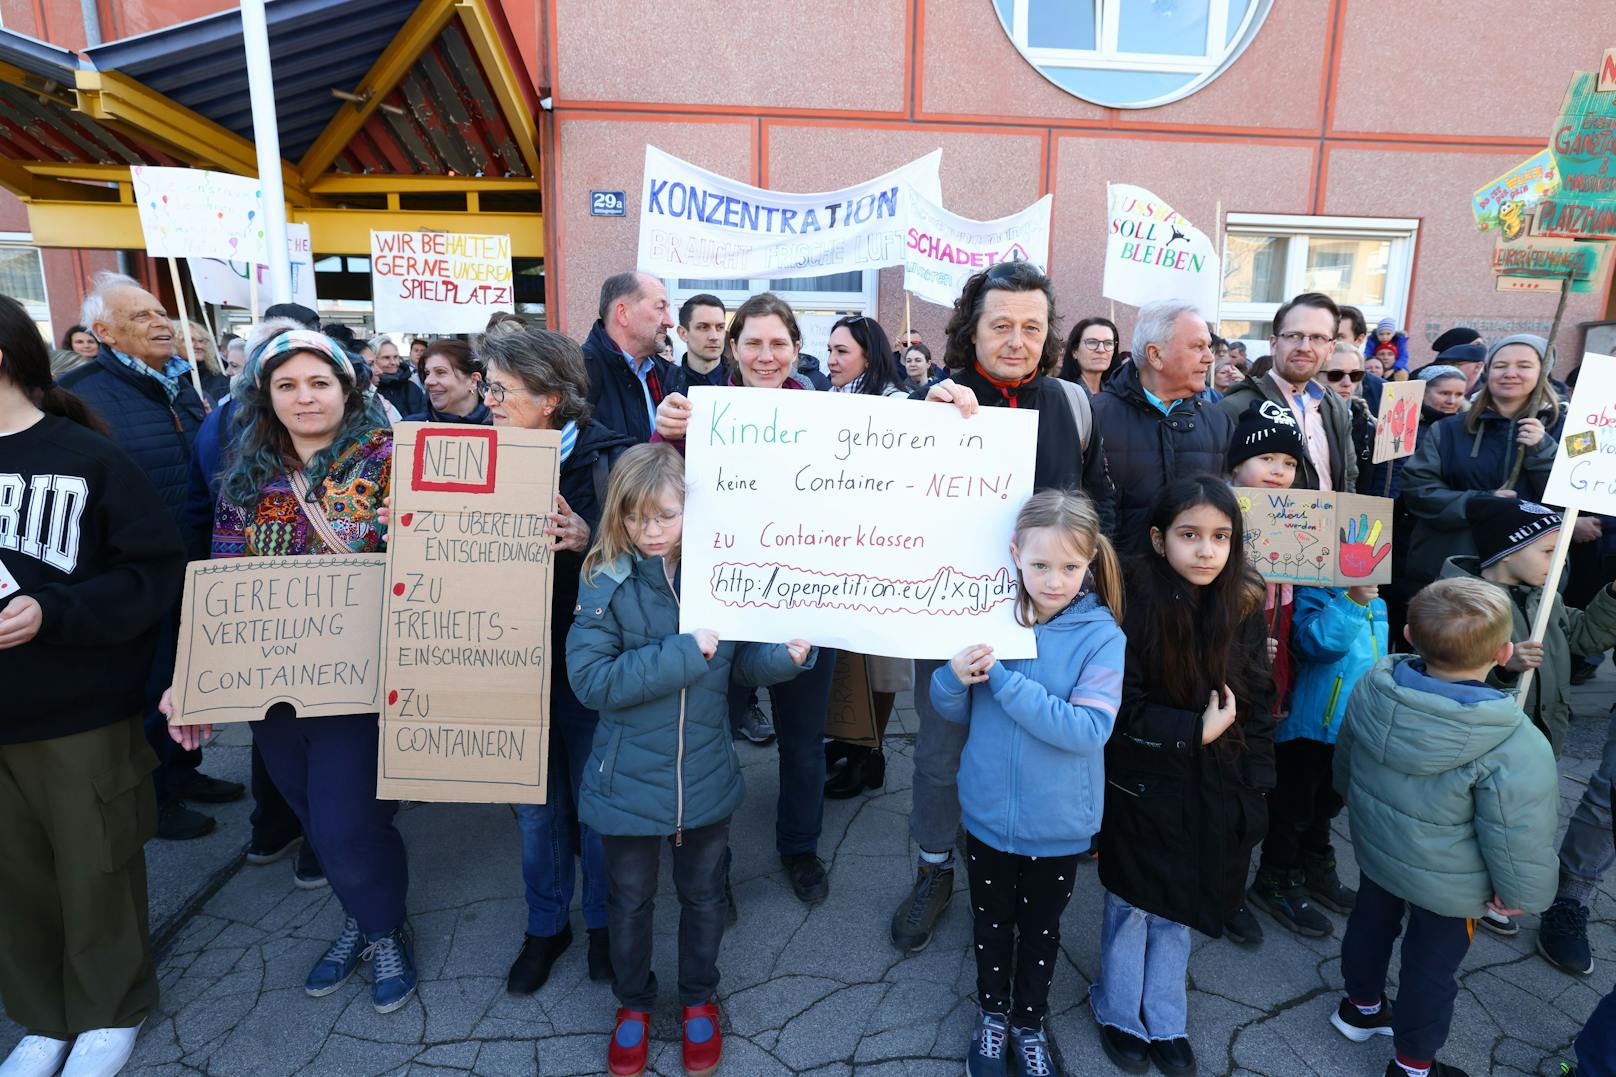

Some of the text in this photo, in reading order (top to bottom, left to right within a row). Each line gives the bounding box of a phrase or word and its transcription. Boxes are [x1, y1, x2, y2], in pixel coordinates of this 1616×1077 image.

[594, 193, 623, 208] 29a
[649, 178, 898, 235] KONZENTRATION
[1110, 218, 1157, 241] SOLL
[376, 234, 508, 259] WIR BEHALTEN
[906, 227, 999, 268] SCHADET
[1121, 242, 1206, 272] BLEIBEN
[375, 255, 511, 282] GERNE UNSEREN
[400, 279, 513, 305] SPIELPLATZ!
[710, 400, 983, 460] Kinder gehören in
[424, 440, 485, 480] NEIN
[716, 466, 758, 491] keine
[795, 464, 895, 492] Container
[926, 473, 1012, 500] NEIN!
[1267, 507, 1308, 526] gehört
[1268, 495, 1295, 509] Wir
[414, 505, 554, 539] ZU ÜBEREILTEN
[759, 521, 925, 550] Containerklassen
[425, 537, 553, 565] ENTSCHEIDUNGEN
[205, 573, 362, 618] GERECHTE
[406, 573, 442, 604] ZU
[202, 613, 344, 646] VERTEILUNG
[261, 642, 298, 658] VON
[399, 644, 542, 667] EINSCHRÄNKUNG
[197, 658, 370, 693] CONTAINERN
[399, 688, 430, 718] ZU
[396, 726, 526, 761] CONTAINERN
